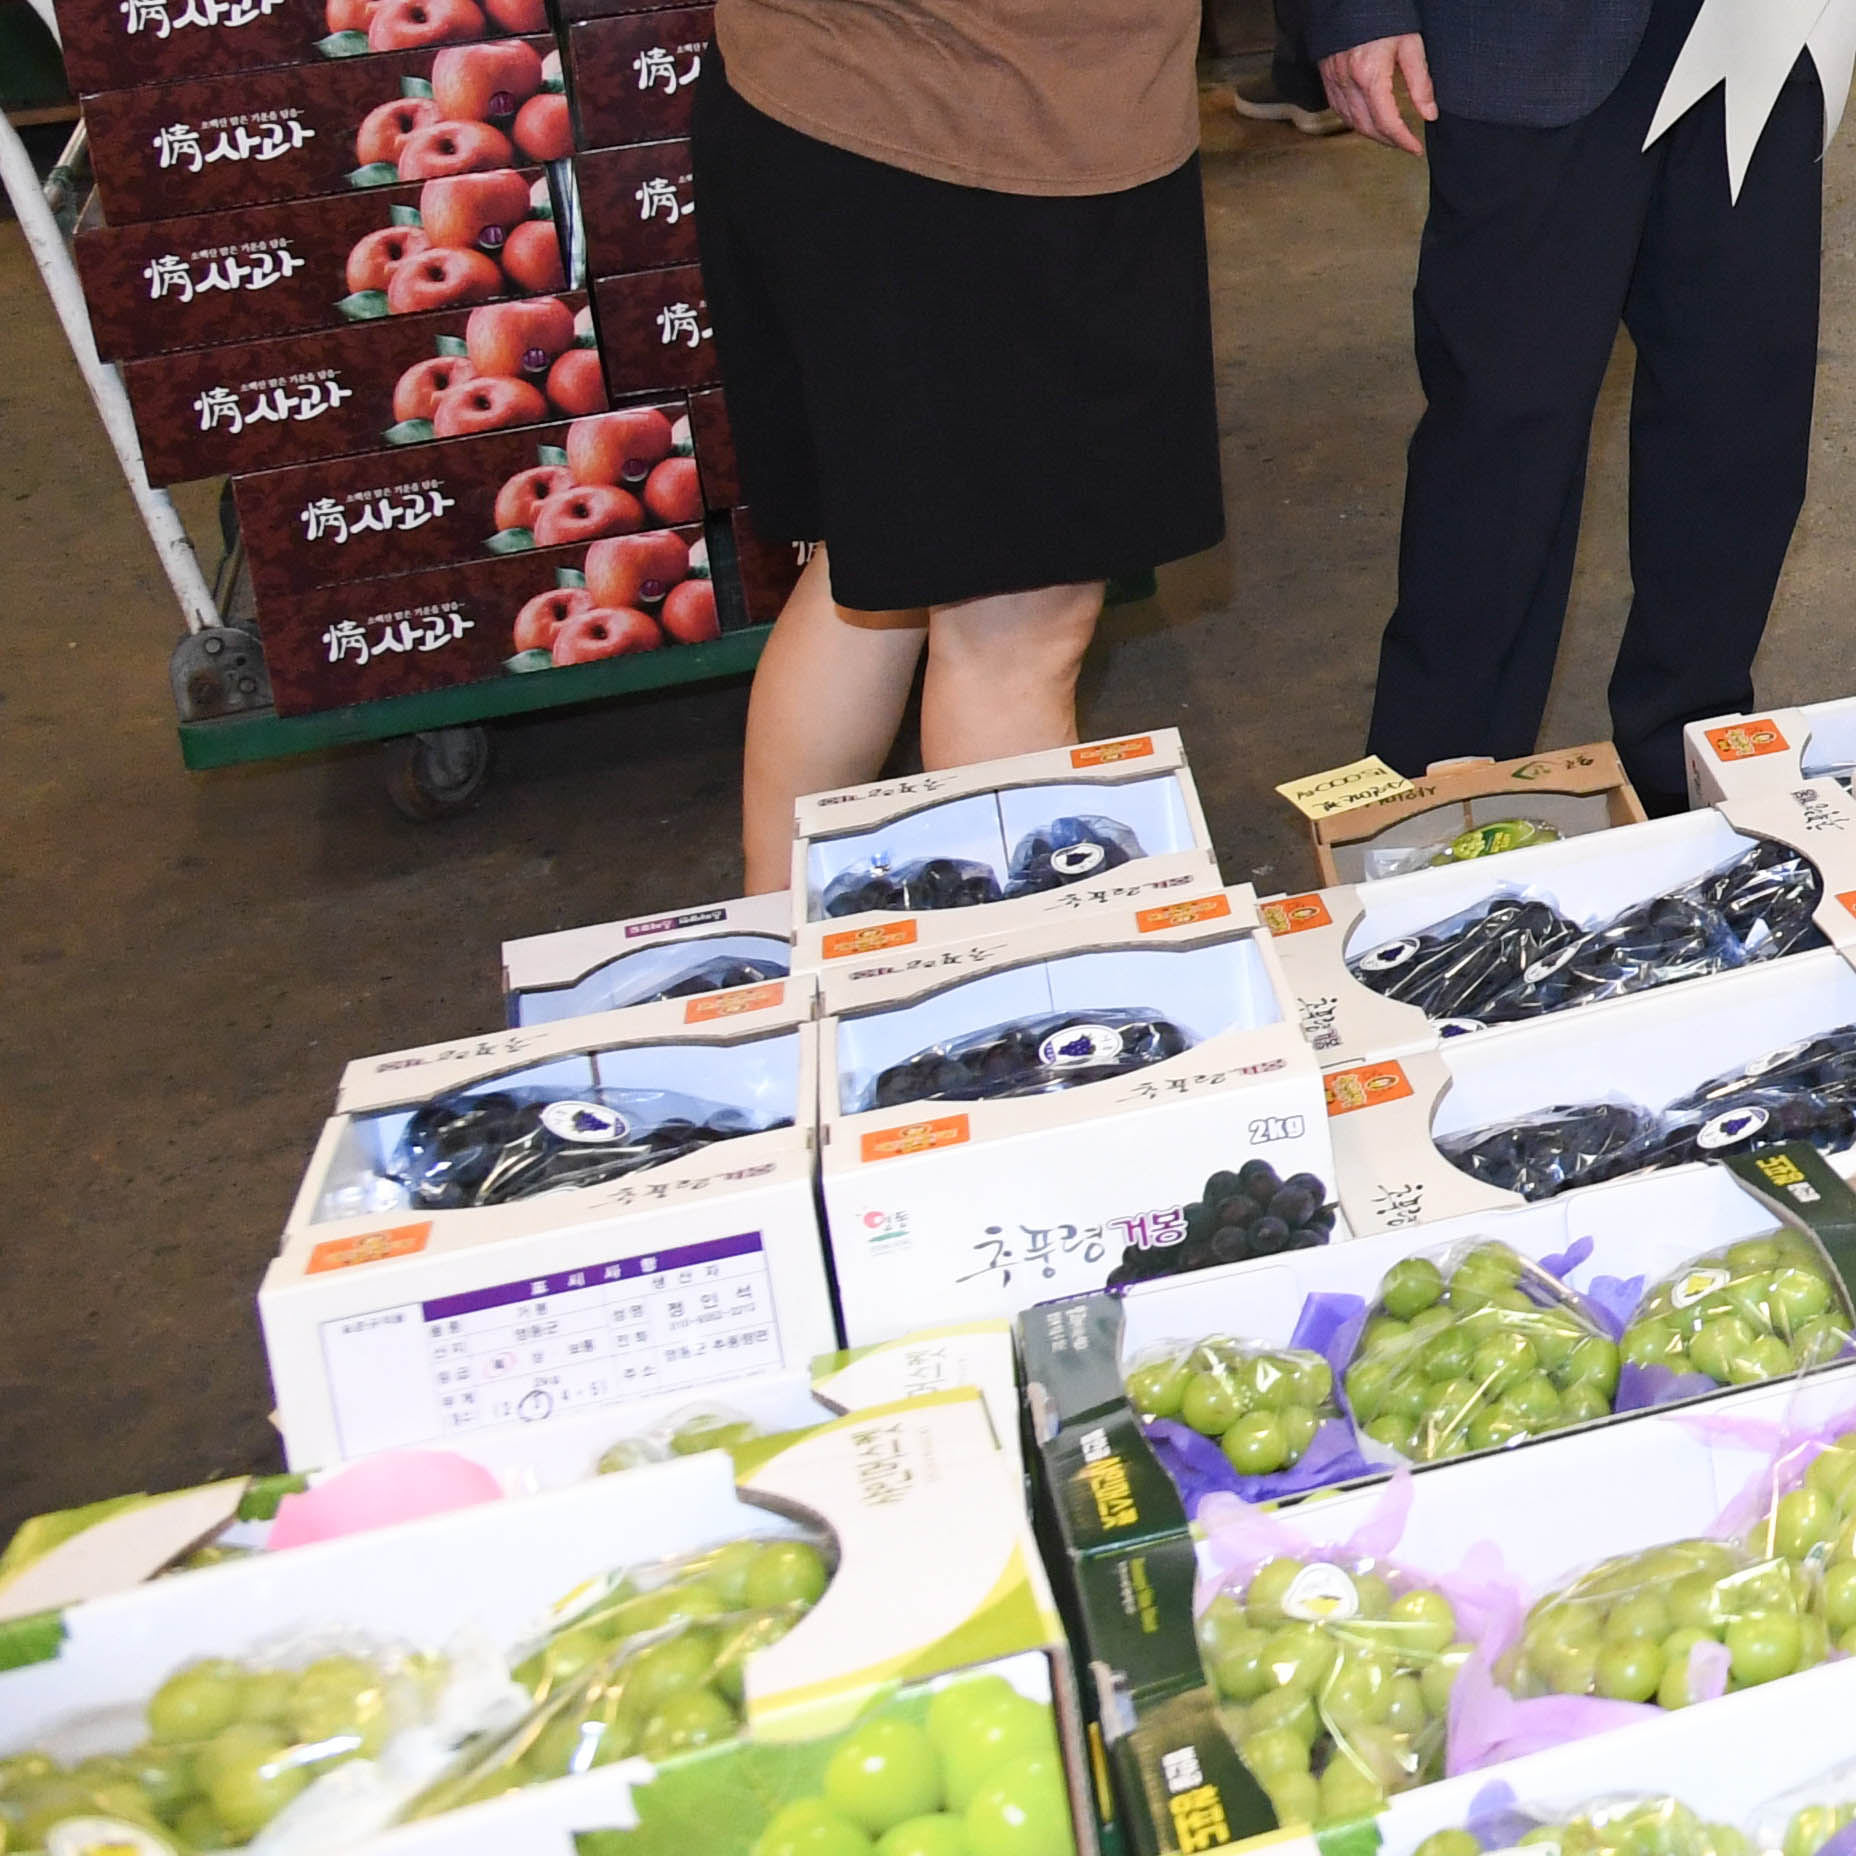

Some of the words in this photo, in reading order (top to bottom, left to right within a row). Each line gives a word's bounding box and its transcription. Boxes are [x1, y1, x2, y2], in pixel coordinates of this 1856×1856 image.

[1248, 1114, 1306, 1146] 2kg
[955, 1221, 1107, 1287] 추풍령
[1107, 1206, 1188, 1249] 거봉
